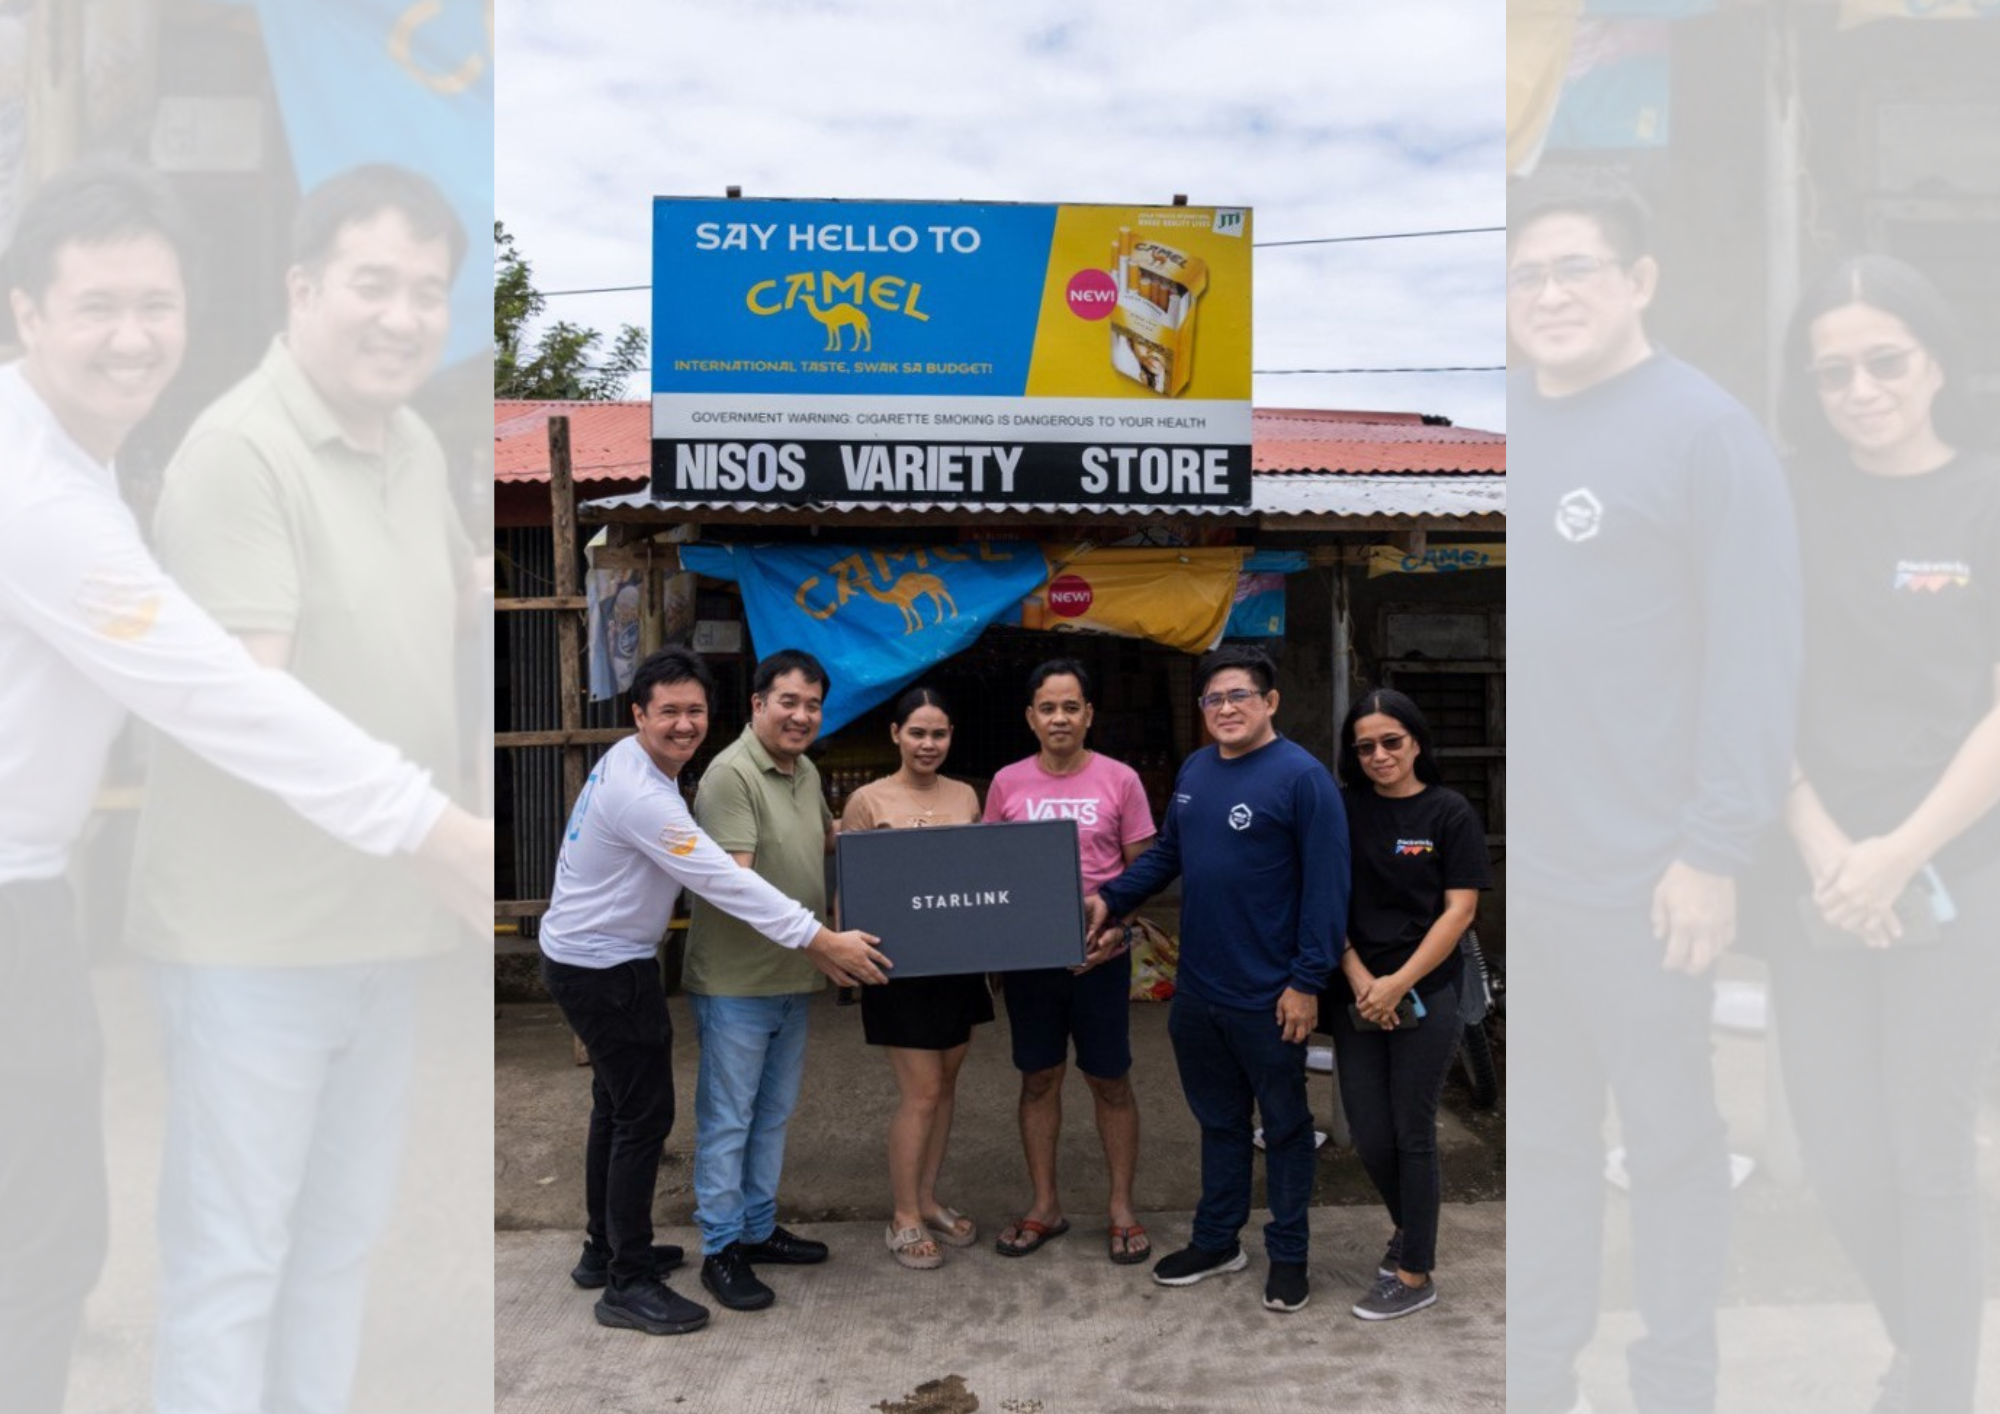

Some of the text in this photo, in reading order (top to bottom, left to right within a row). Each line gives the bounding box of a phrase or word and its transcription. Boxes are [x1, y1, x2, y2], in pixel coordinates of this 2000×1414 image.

[696, 222, 981, 253] SAY HELLO TO
[1134, 242, 1188, 269] CAMEL
[746, 270, 930, 322] CAMEL
[1070, 289, 1115, 303] NEW!
[675, 360, 993, 375] INTERNATIONAL TASTE, SWAK SA BUDGET!
[691, 411, 783, 423] GOVERNMENT
[856, 413, 930, 425] CIGARETTE
[934, 414, 994, 425] SMOKING
[998, 414, 1010, 425] IS
[1013, 415, 1094, 426] DANGEROUS
[1099, 416, 1115, 427] TO
[1118, 416, 1154, 428] YOUR
[1157, 417, 1206, 428] HEALTH
[676, 443, 1229, 494] NISOS VARIETY STORE
[1051, 591, 1091, 604] NEW!
[1026, 798, 1099, 825] VANS
[912, 891, 1010, 910] STARLINK
